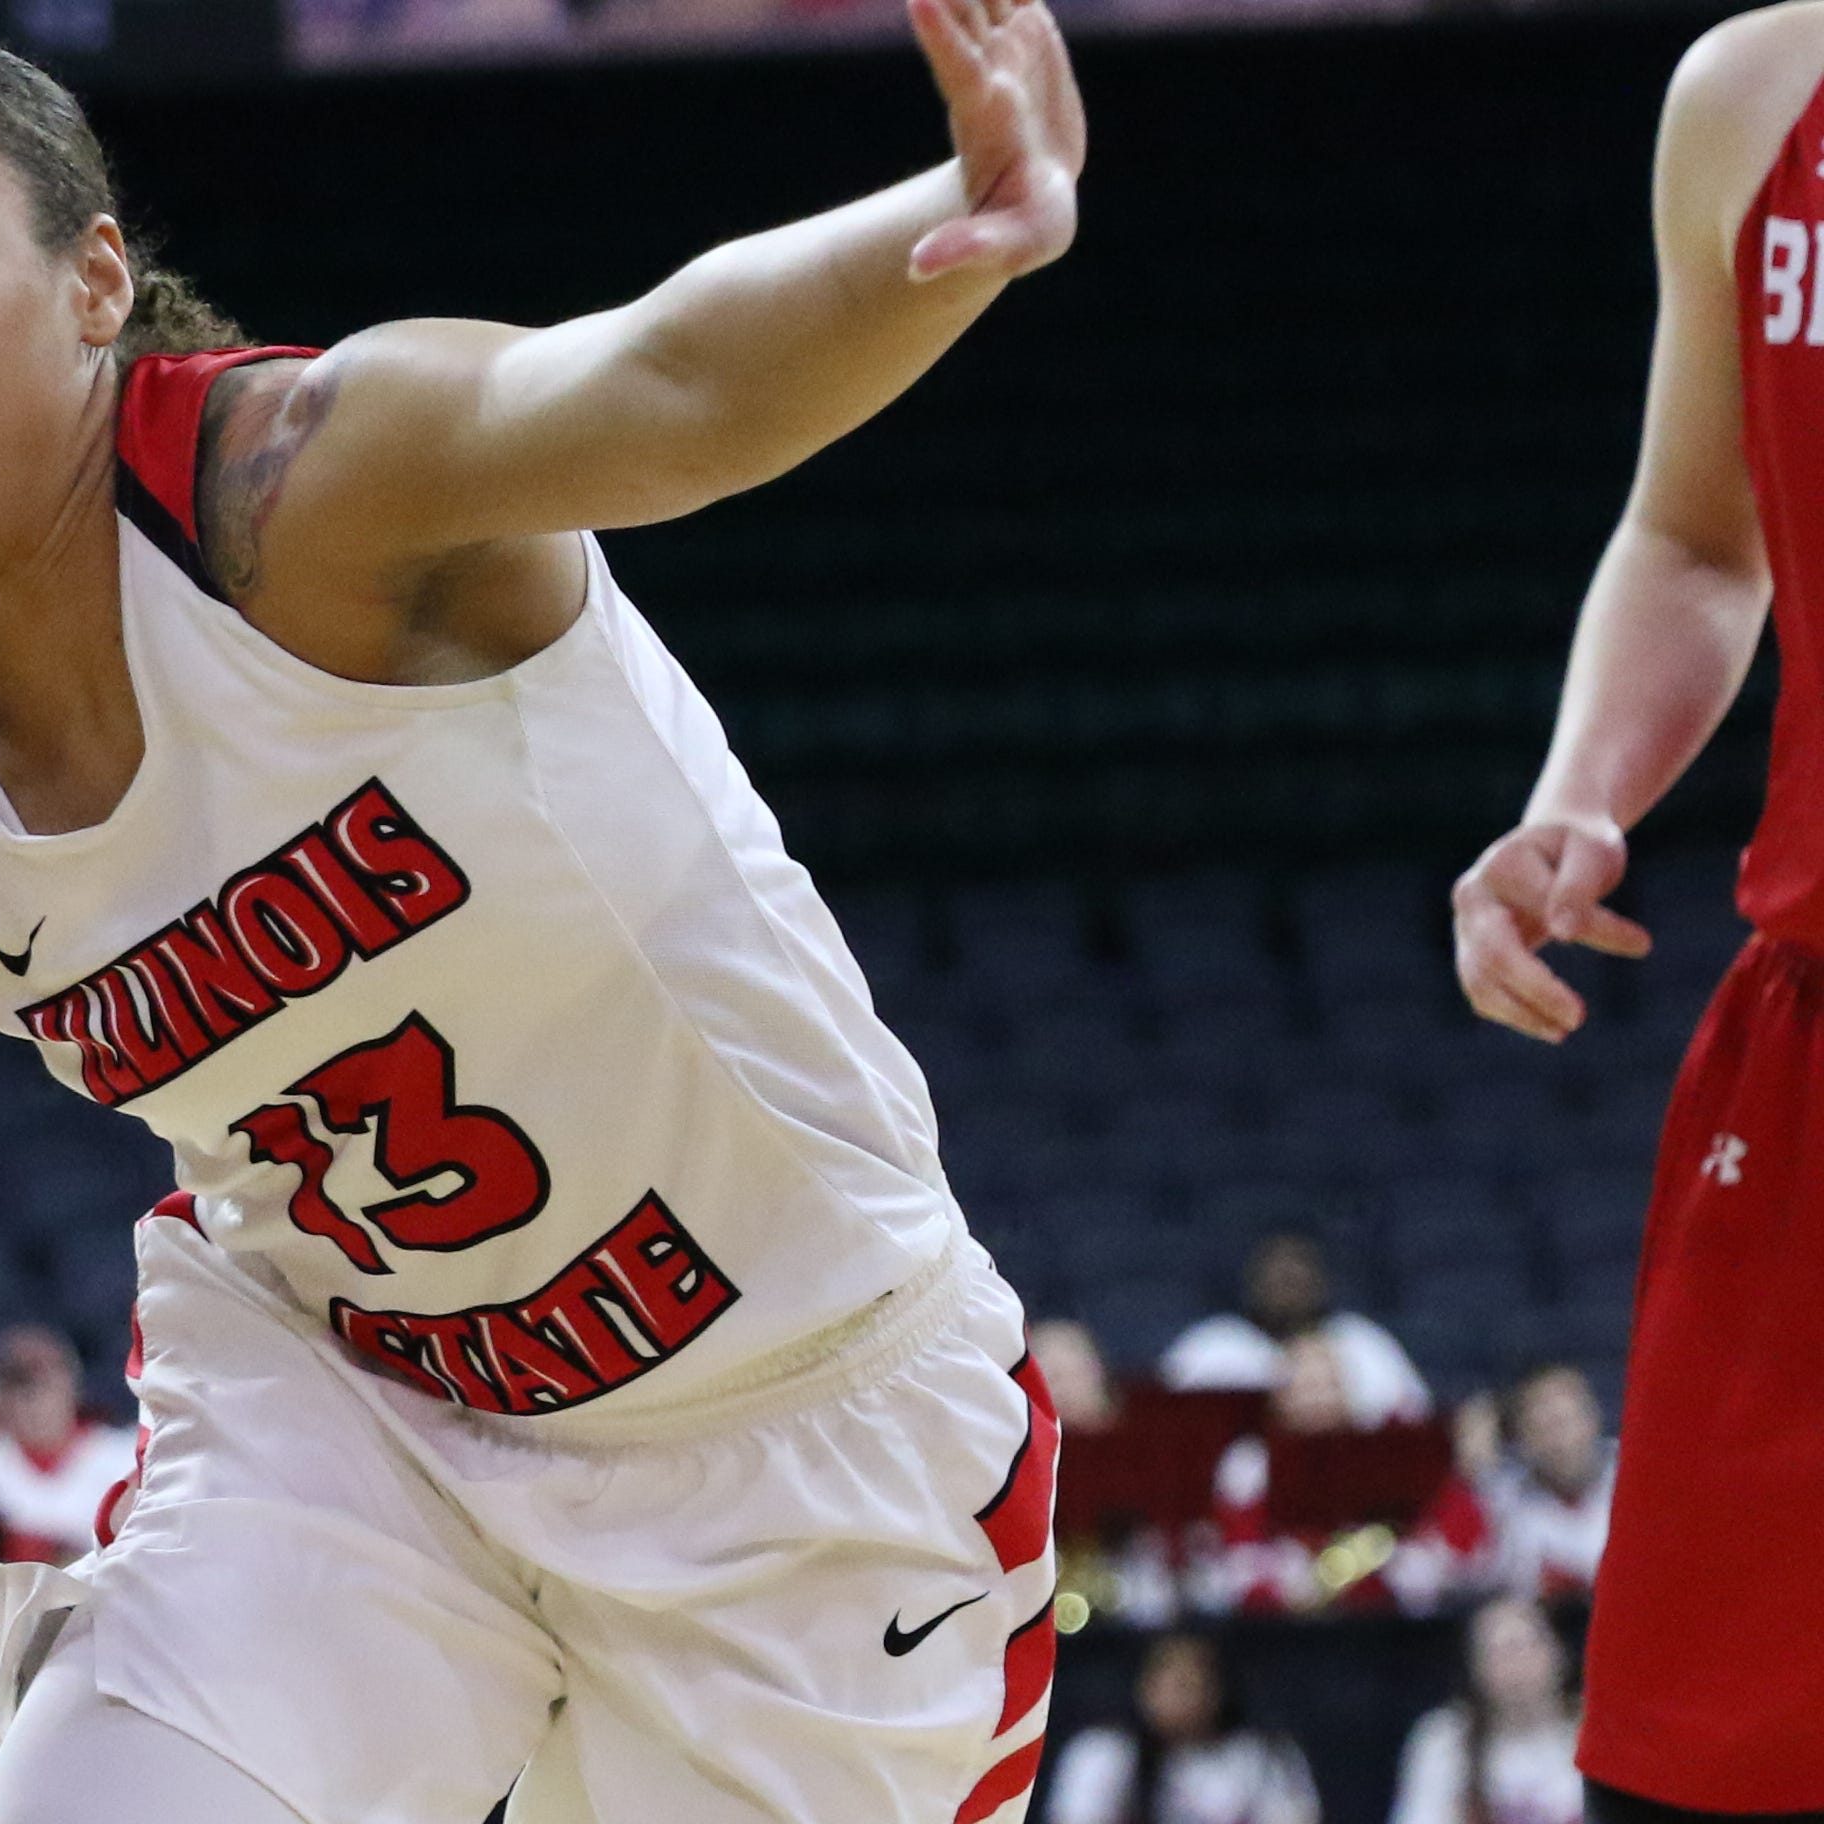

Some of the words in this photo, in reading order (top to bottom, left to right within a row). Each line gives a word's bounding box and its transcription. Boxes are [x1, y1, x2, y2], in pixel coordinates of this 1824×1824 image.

[15, 775, 472, 1108] ILLINOIS
[228, 1009, 552, 1276] 13
[329, 1187, 743, 1417] STATE
